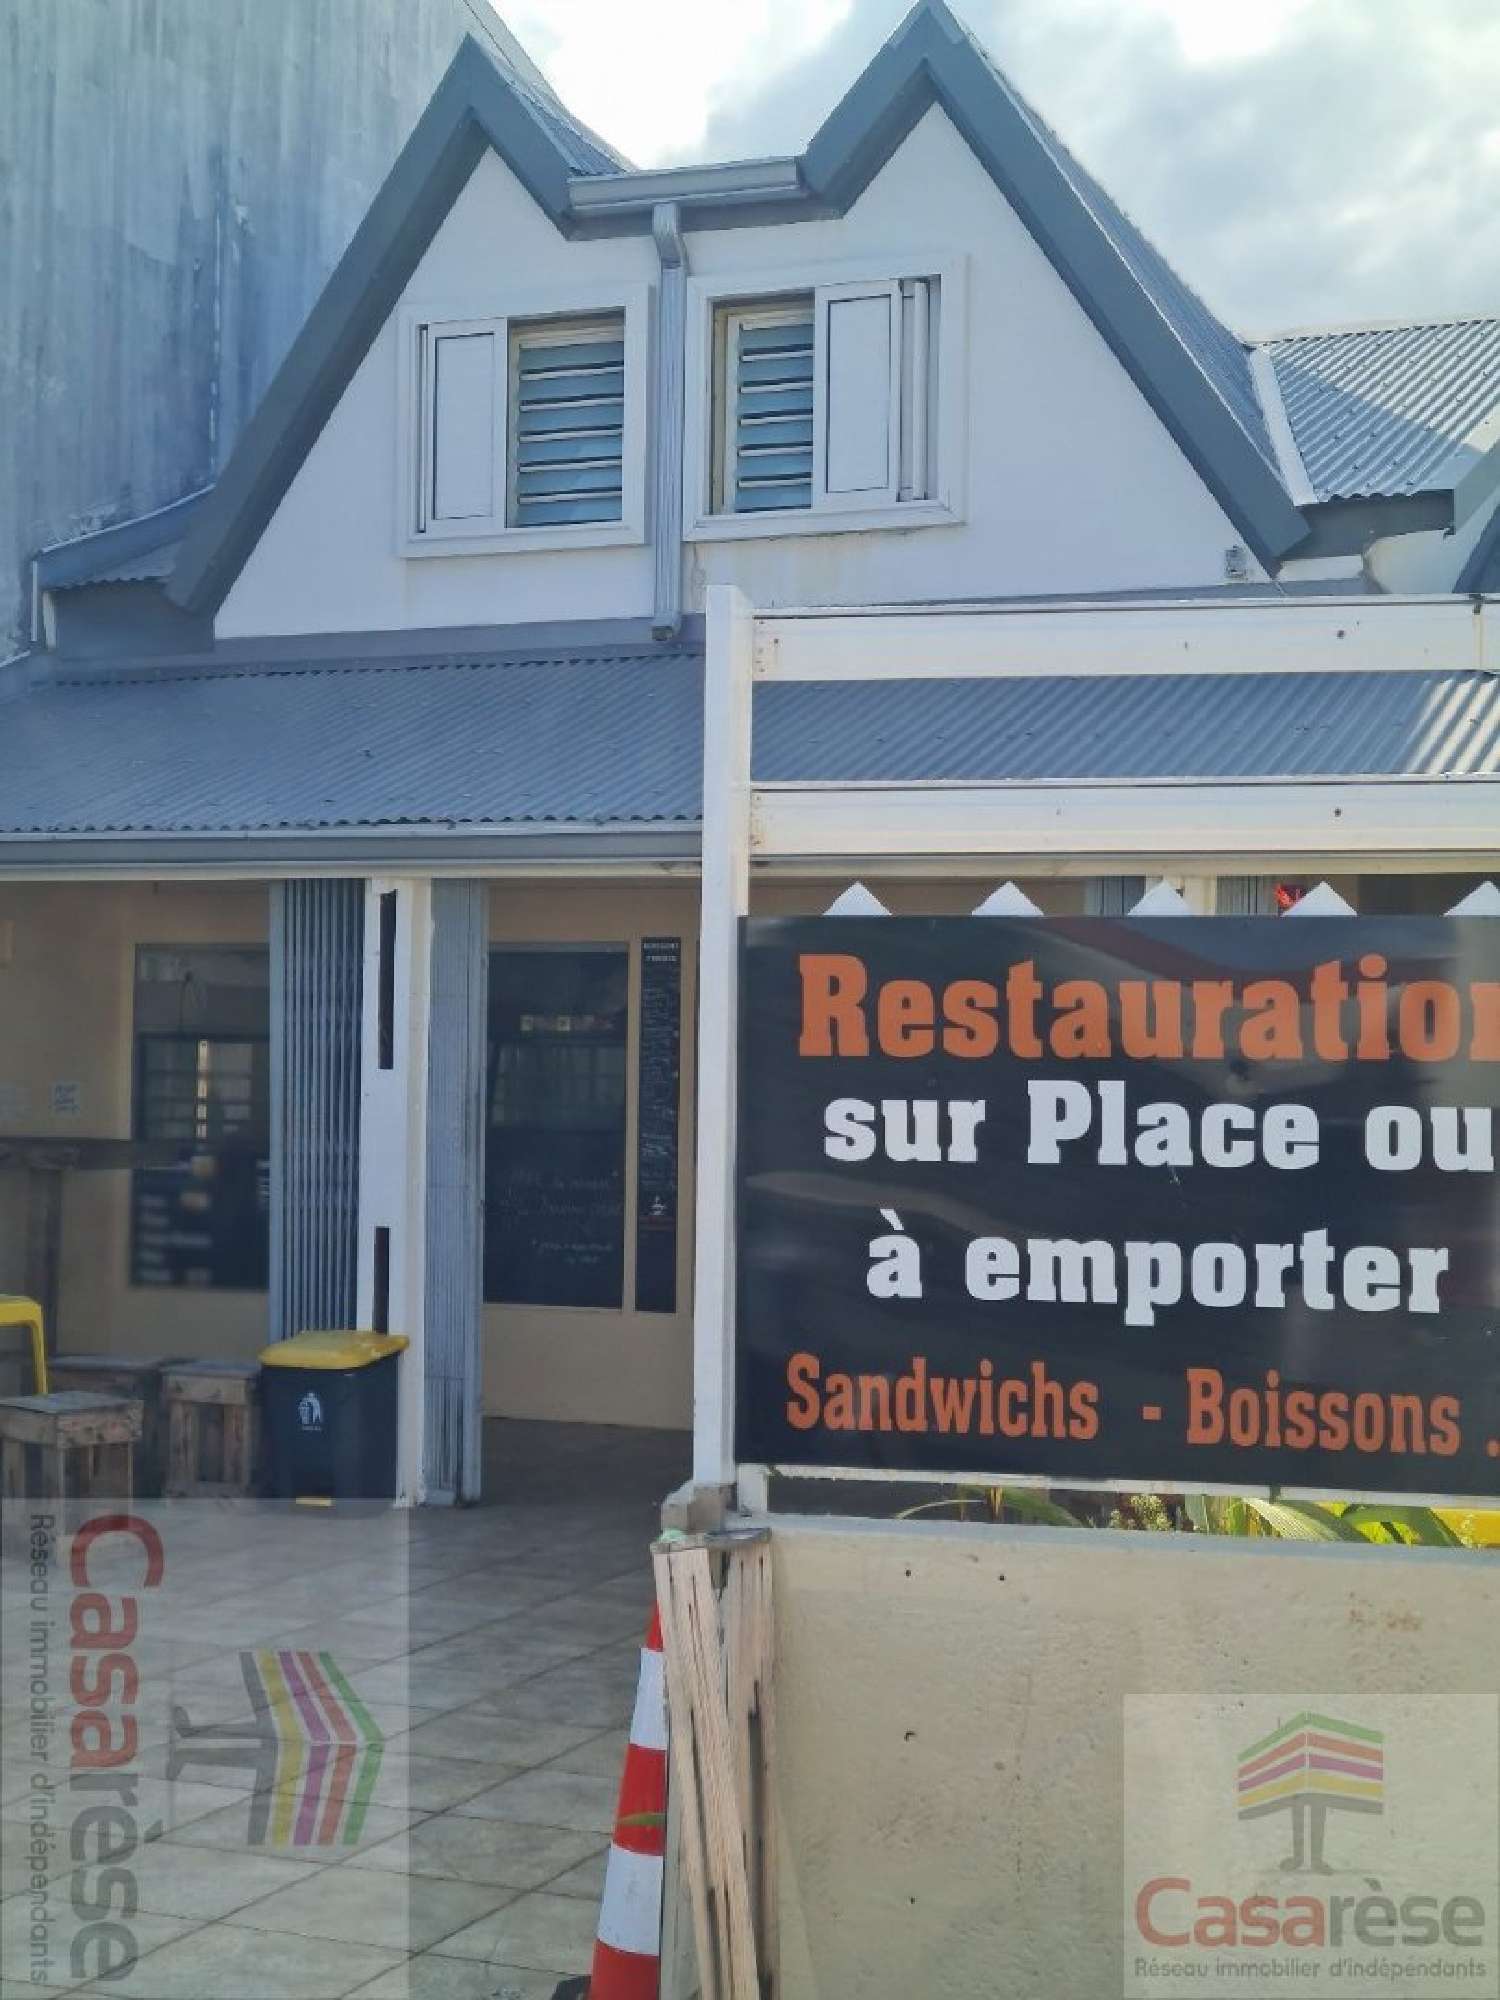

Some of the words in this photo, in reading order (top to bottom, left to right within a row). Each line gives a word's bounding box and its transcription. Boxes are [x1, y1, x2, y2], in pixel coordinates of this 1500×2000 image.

[825, 1097, 986, 1162] sur
[1027, 1079, 1320, 1170] Place
[1364, 1104, 1494, 1171] ou
[866, 1208, 923, 1299] à
[965, 1228, 1449, 1327] emporter
[786, 1353, 1099, 1440] Sandwichs
[1186, 1368, 1460, 1456] Boissons
